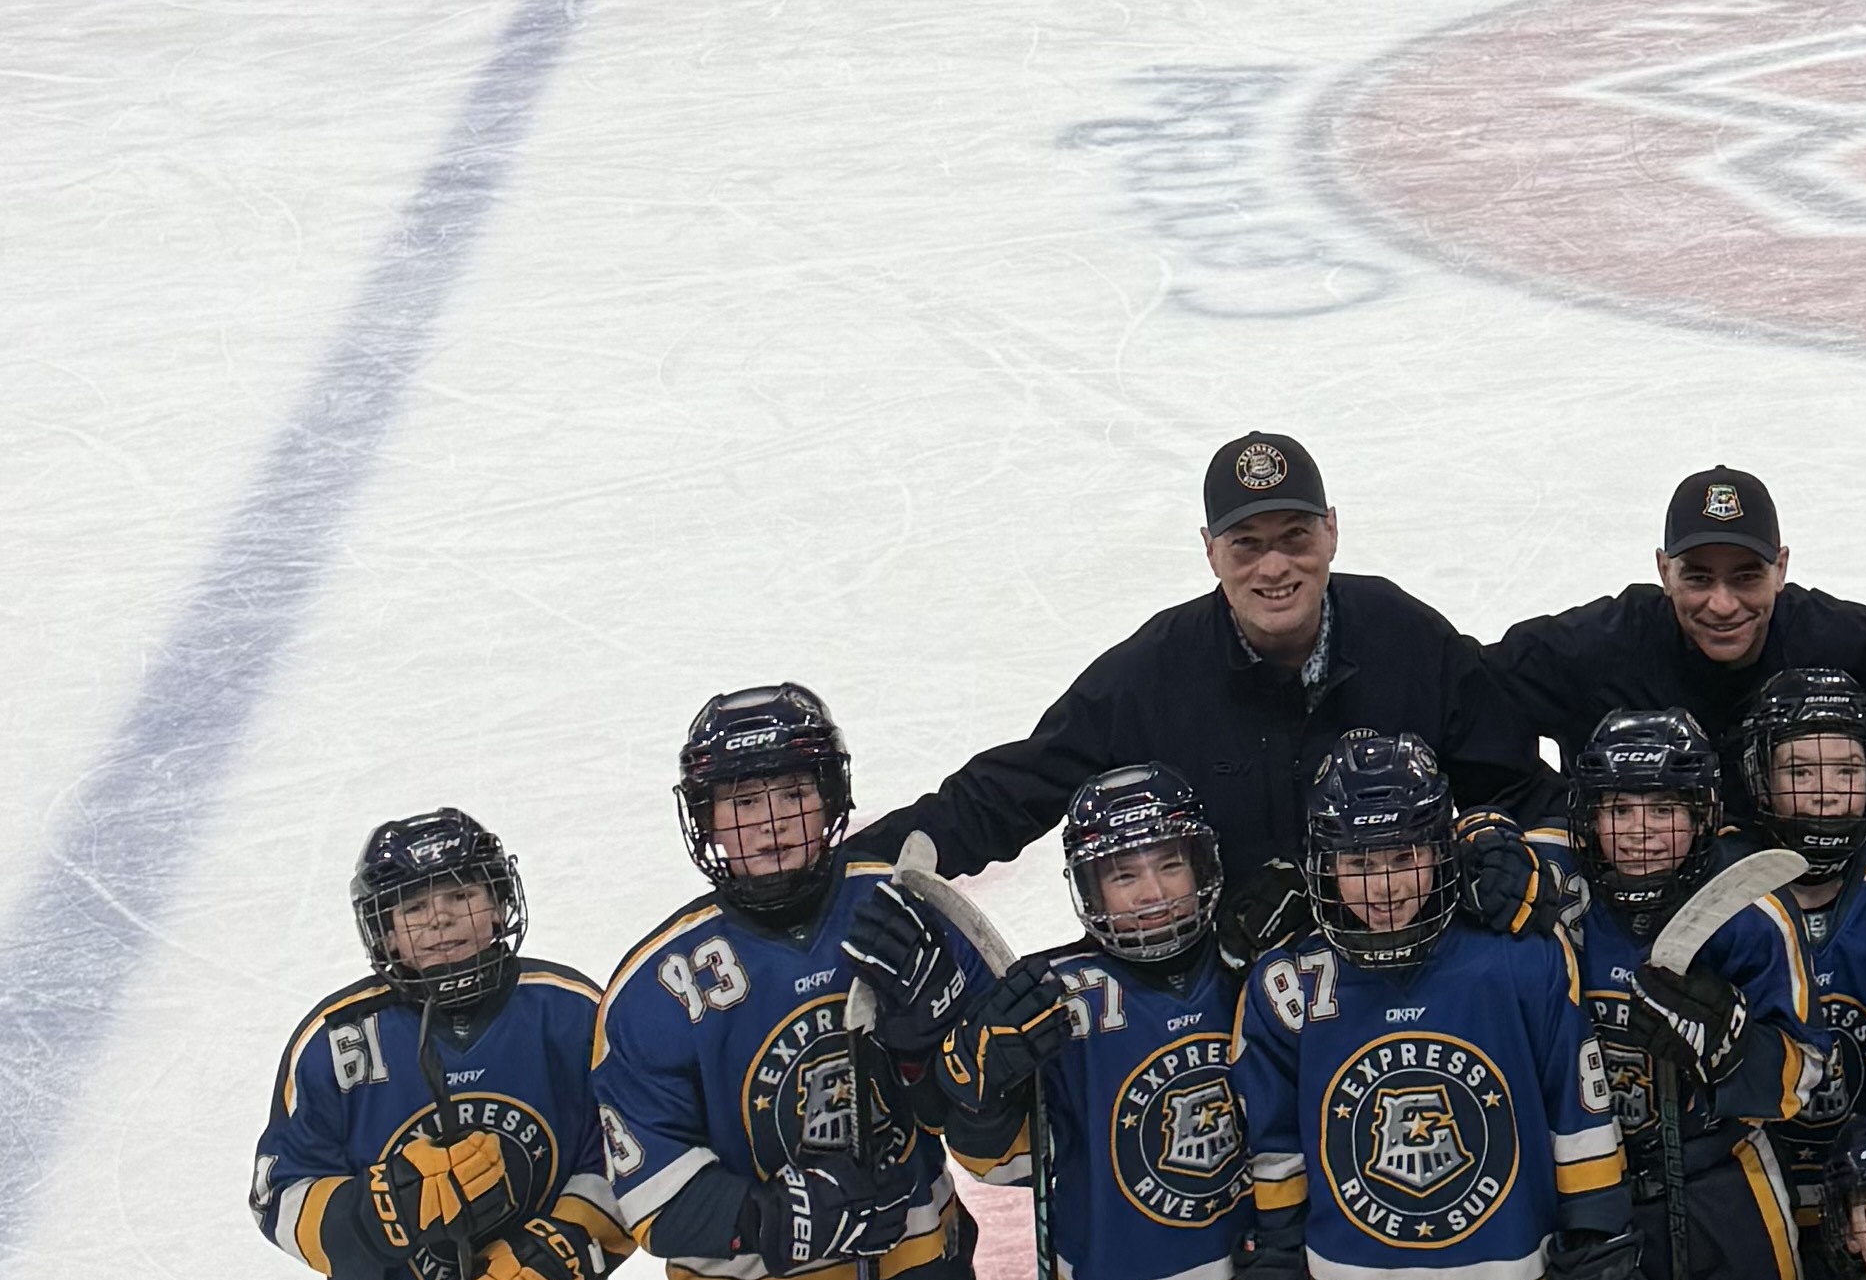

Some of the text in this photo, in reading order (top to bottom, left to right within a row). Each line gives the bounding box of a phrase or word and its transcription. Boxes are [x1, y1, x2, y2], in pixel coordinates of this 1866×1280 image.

[726, 731, 778, 751] CCM
[1613, 751, 1664, 763] CCM
[1109, 805, 1163, 827] CCM
[1354, 811, 1399, 827] CCM
[658, 936, 750, 1023] 93
[1263, 949, 1340, 1034] 87
[329, 1012, 390, 1093] 61
[759, 1008, 834, 1085] EXPR
[1129, 1041, 1232, 1108] EXPRE
[1341, 1042, 1488, 1101] EXPRESS
[397, 1103, 538, 1155] XRESS
[369, 1163, 410, 1247] CCM
[1134, 1175, 1197, 1219] RIVE
[1341, 1175, 1500, 1238] RIVE SUD
